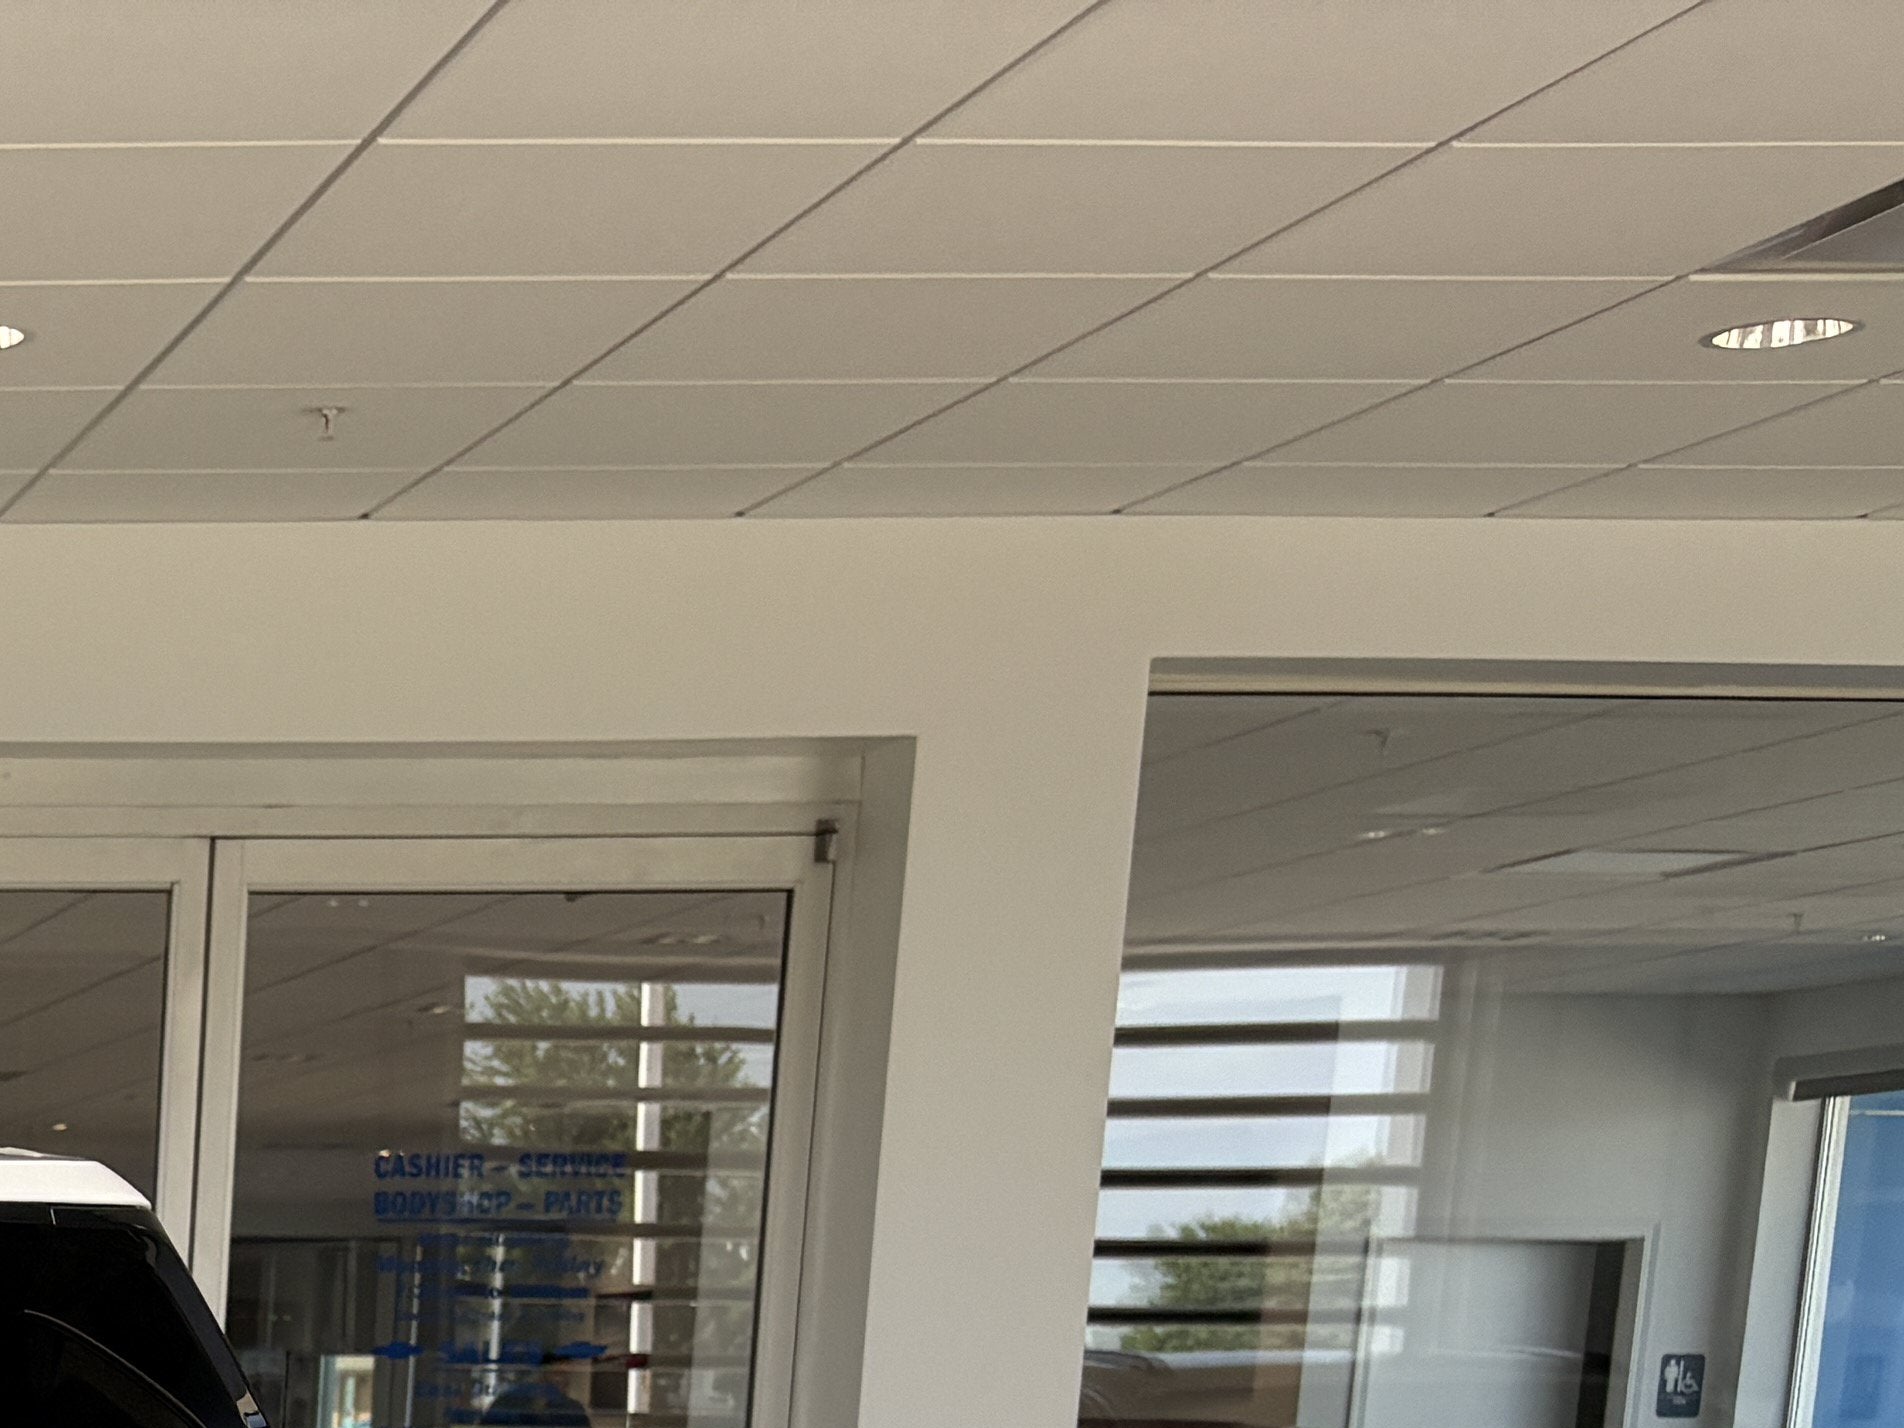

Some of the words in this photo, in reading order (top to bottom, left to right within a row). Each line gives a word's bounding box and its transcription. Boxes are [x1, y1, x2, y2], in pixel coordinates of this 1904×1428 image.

[374, 1153, 485, 1179] CASHIER
[518, 1152, 627, 1179] SERVICE
[544, 1190, 622, 1216] PARTS
